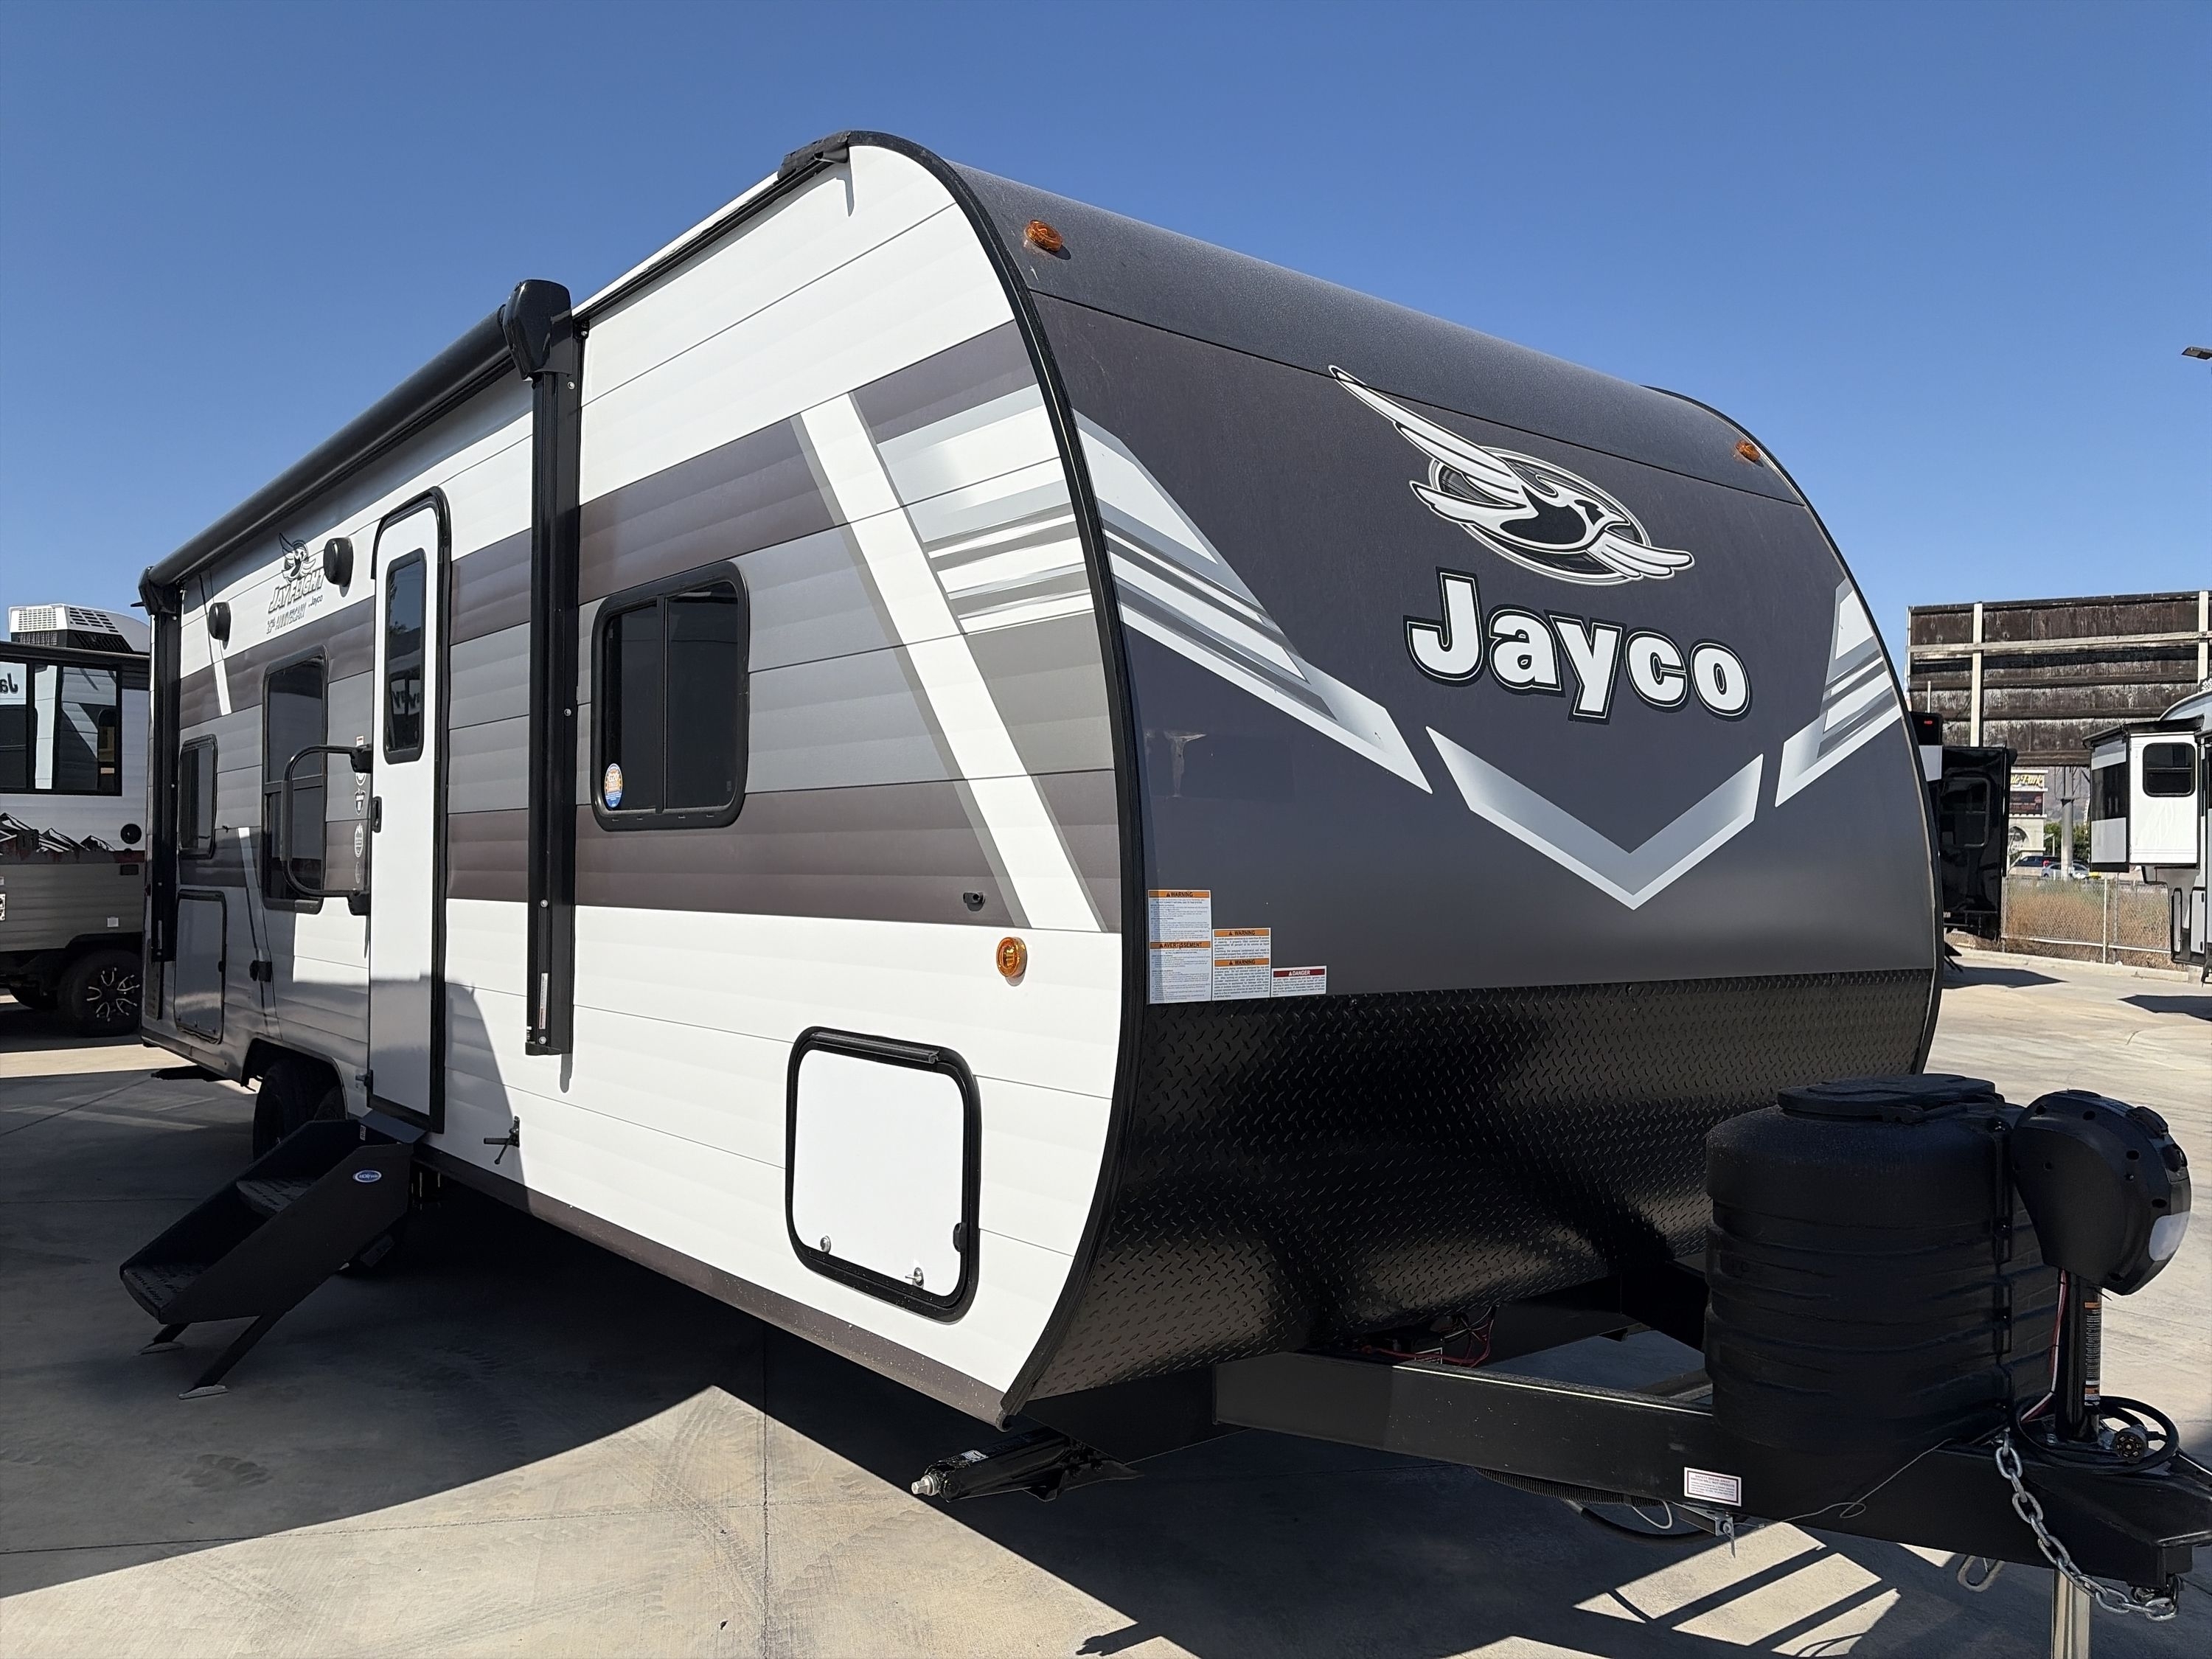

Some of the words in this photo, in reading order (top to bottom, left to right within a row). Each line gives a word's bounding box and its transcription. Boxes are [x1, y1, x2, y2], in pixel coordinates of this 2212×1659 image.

[268, 583, 291, 614] JAY
[288, 566, 324, 605] FLIGHT
[1403, 566, 1753, 725] Jayco
[2020, 774, 2043, 788] Park
